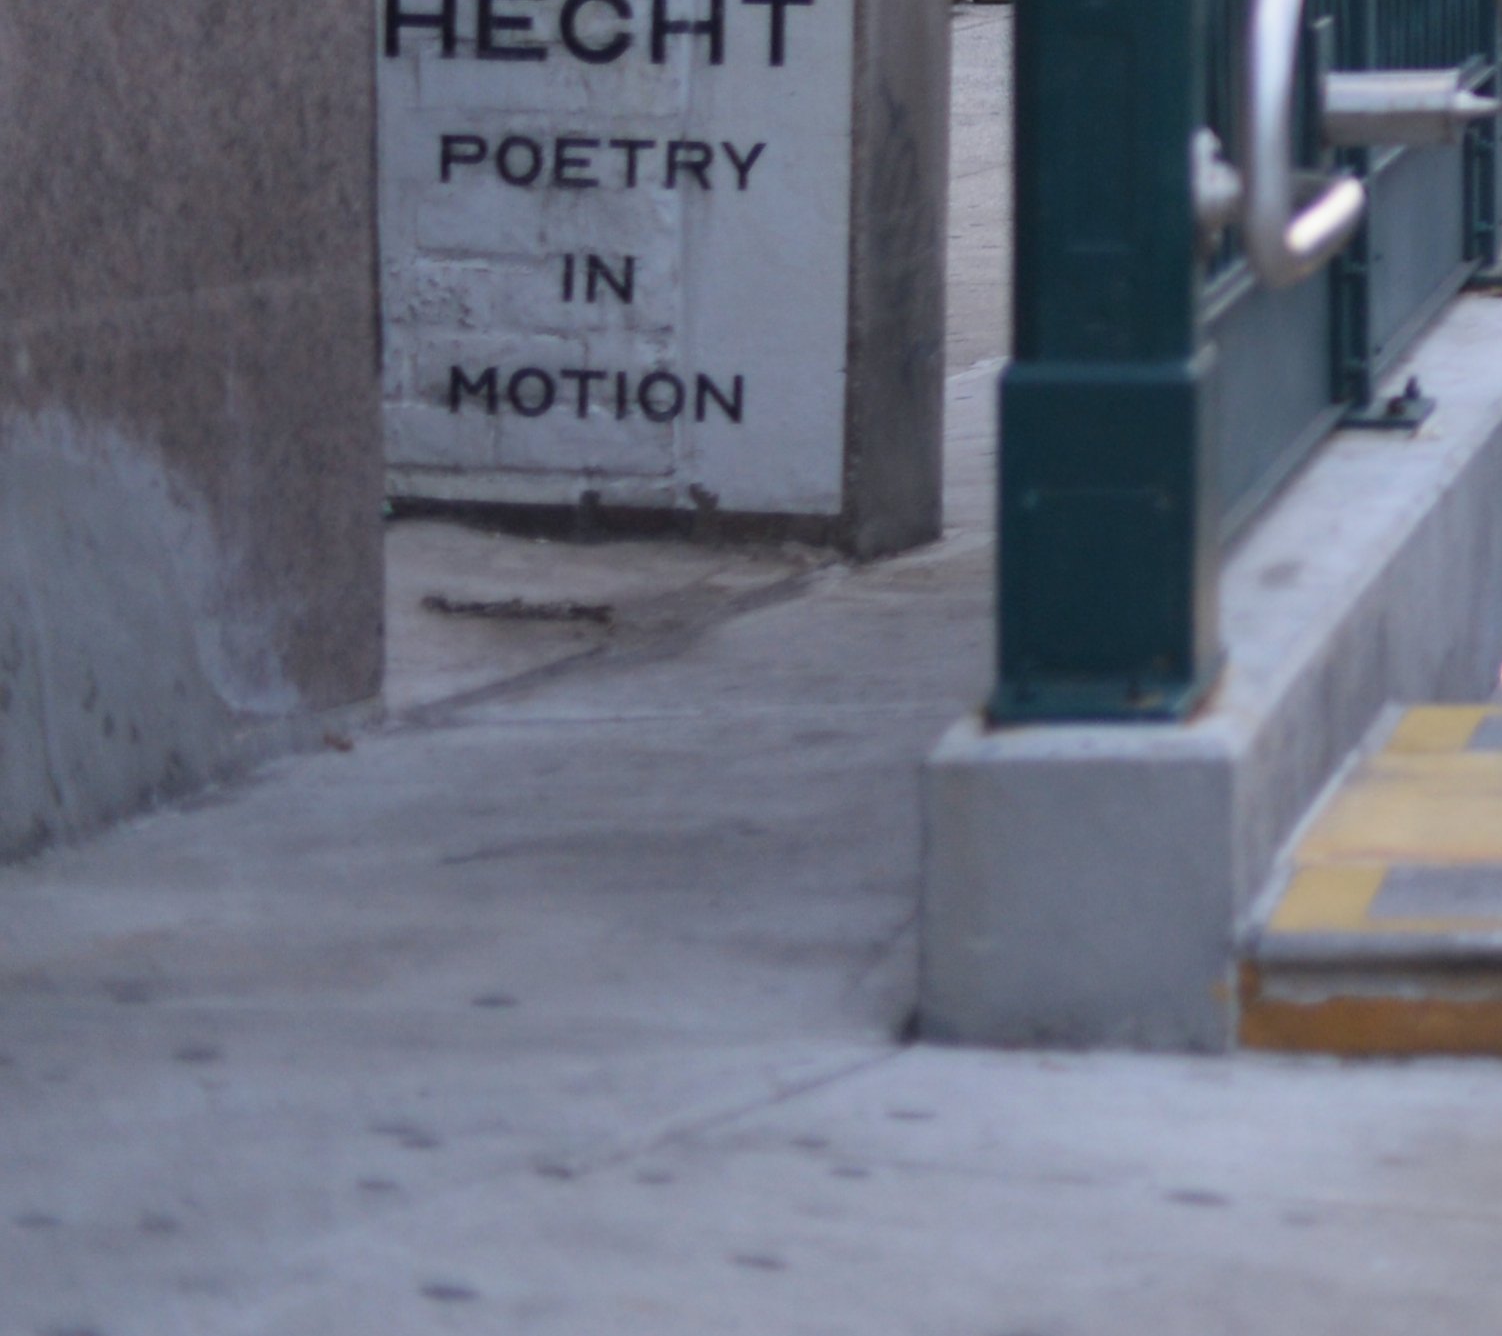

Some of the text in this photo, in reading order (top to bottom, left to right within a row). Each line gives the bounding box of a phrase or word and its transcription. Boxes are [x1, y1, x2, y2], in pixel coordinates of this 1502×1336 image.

[439, 133, 767, 192] POETRY
[561, 254, 636, 305] IN
[448, 366, 746, 424] MOTION
